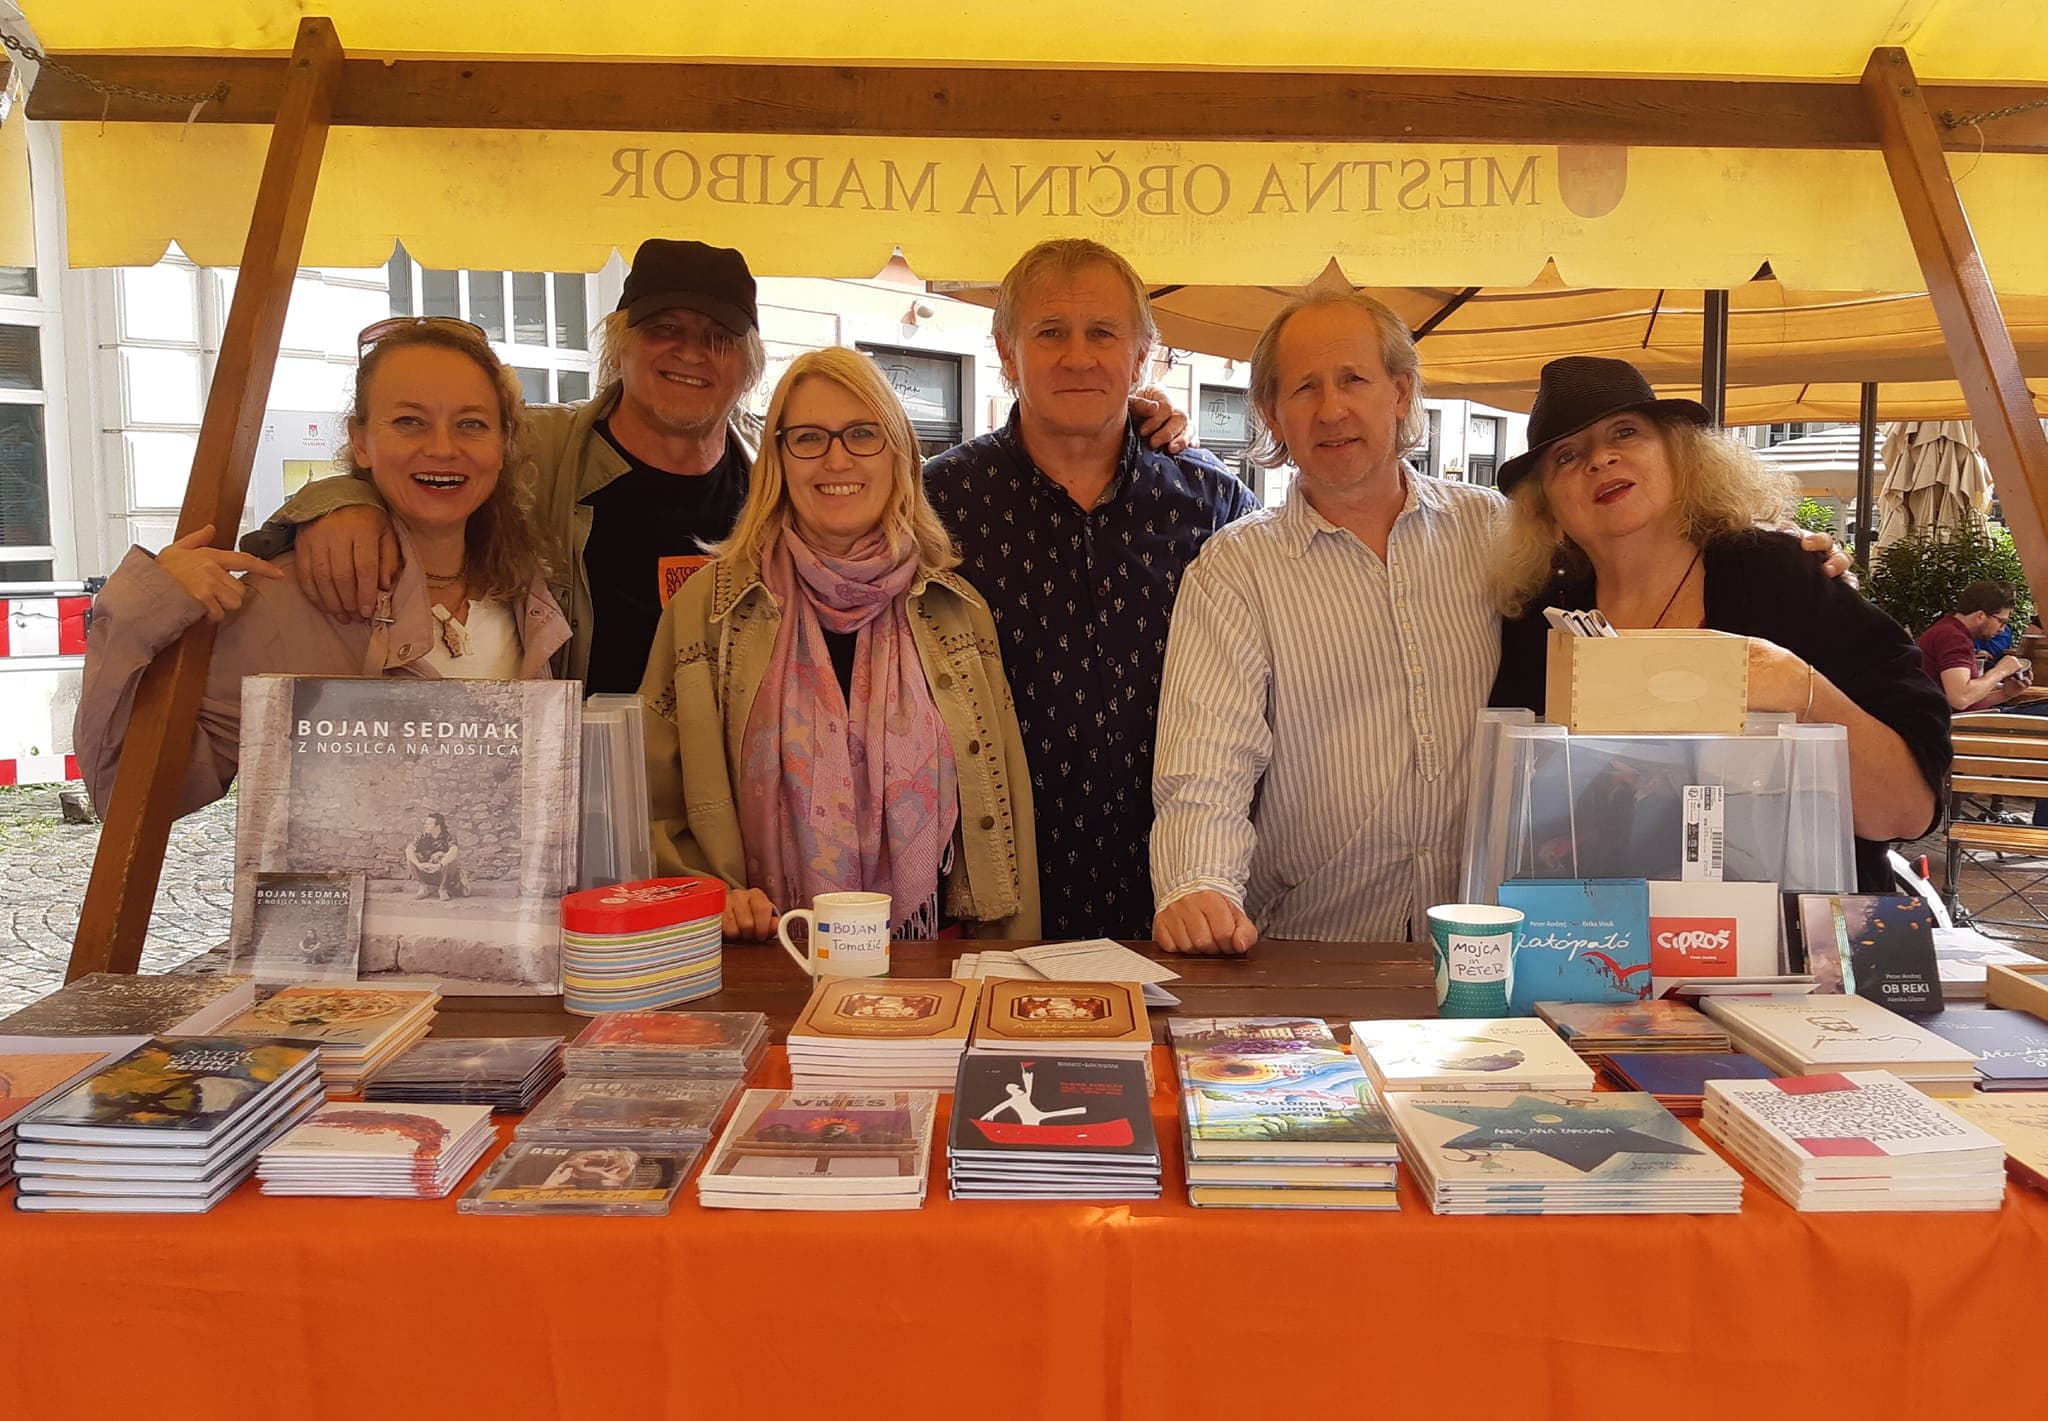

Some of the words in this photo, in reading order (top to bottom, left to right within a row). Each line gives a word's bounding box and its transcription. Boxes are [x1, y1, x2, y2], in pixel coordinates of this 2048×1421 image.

[298, 719, 390, 738] BOJAN
[403, 721, 519, 739] SEDMAK
[298, 741, 307, 753] Z
[317, 741, 397, 755] NOSILCA
[406, 743, 430, 755] NA
[440, 744, 519, 756] NOSILCA
[257, 890, 296, 898] BOJAN
[300, 890, 349, 898] SEDMAK
[1546, 920, 1567, 928] Andrej
[832, 938, 882, 952] Tomažič
[1455, 963, 1505, 976] PETER
[1881, 983, 1900, 993] OB
[1902, 983, 1930, 993] REKI
